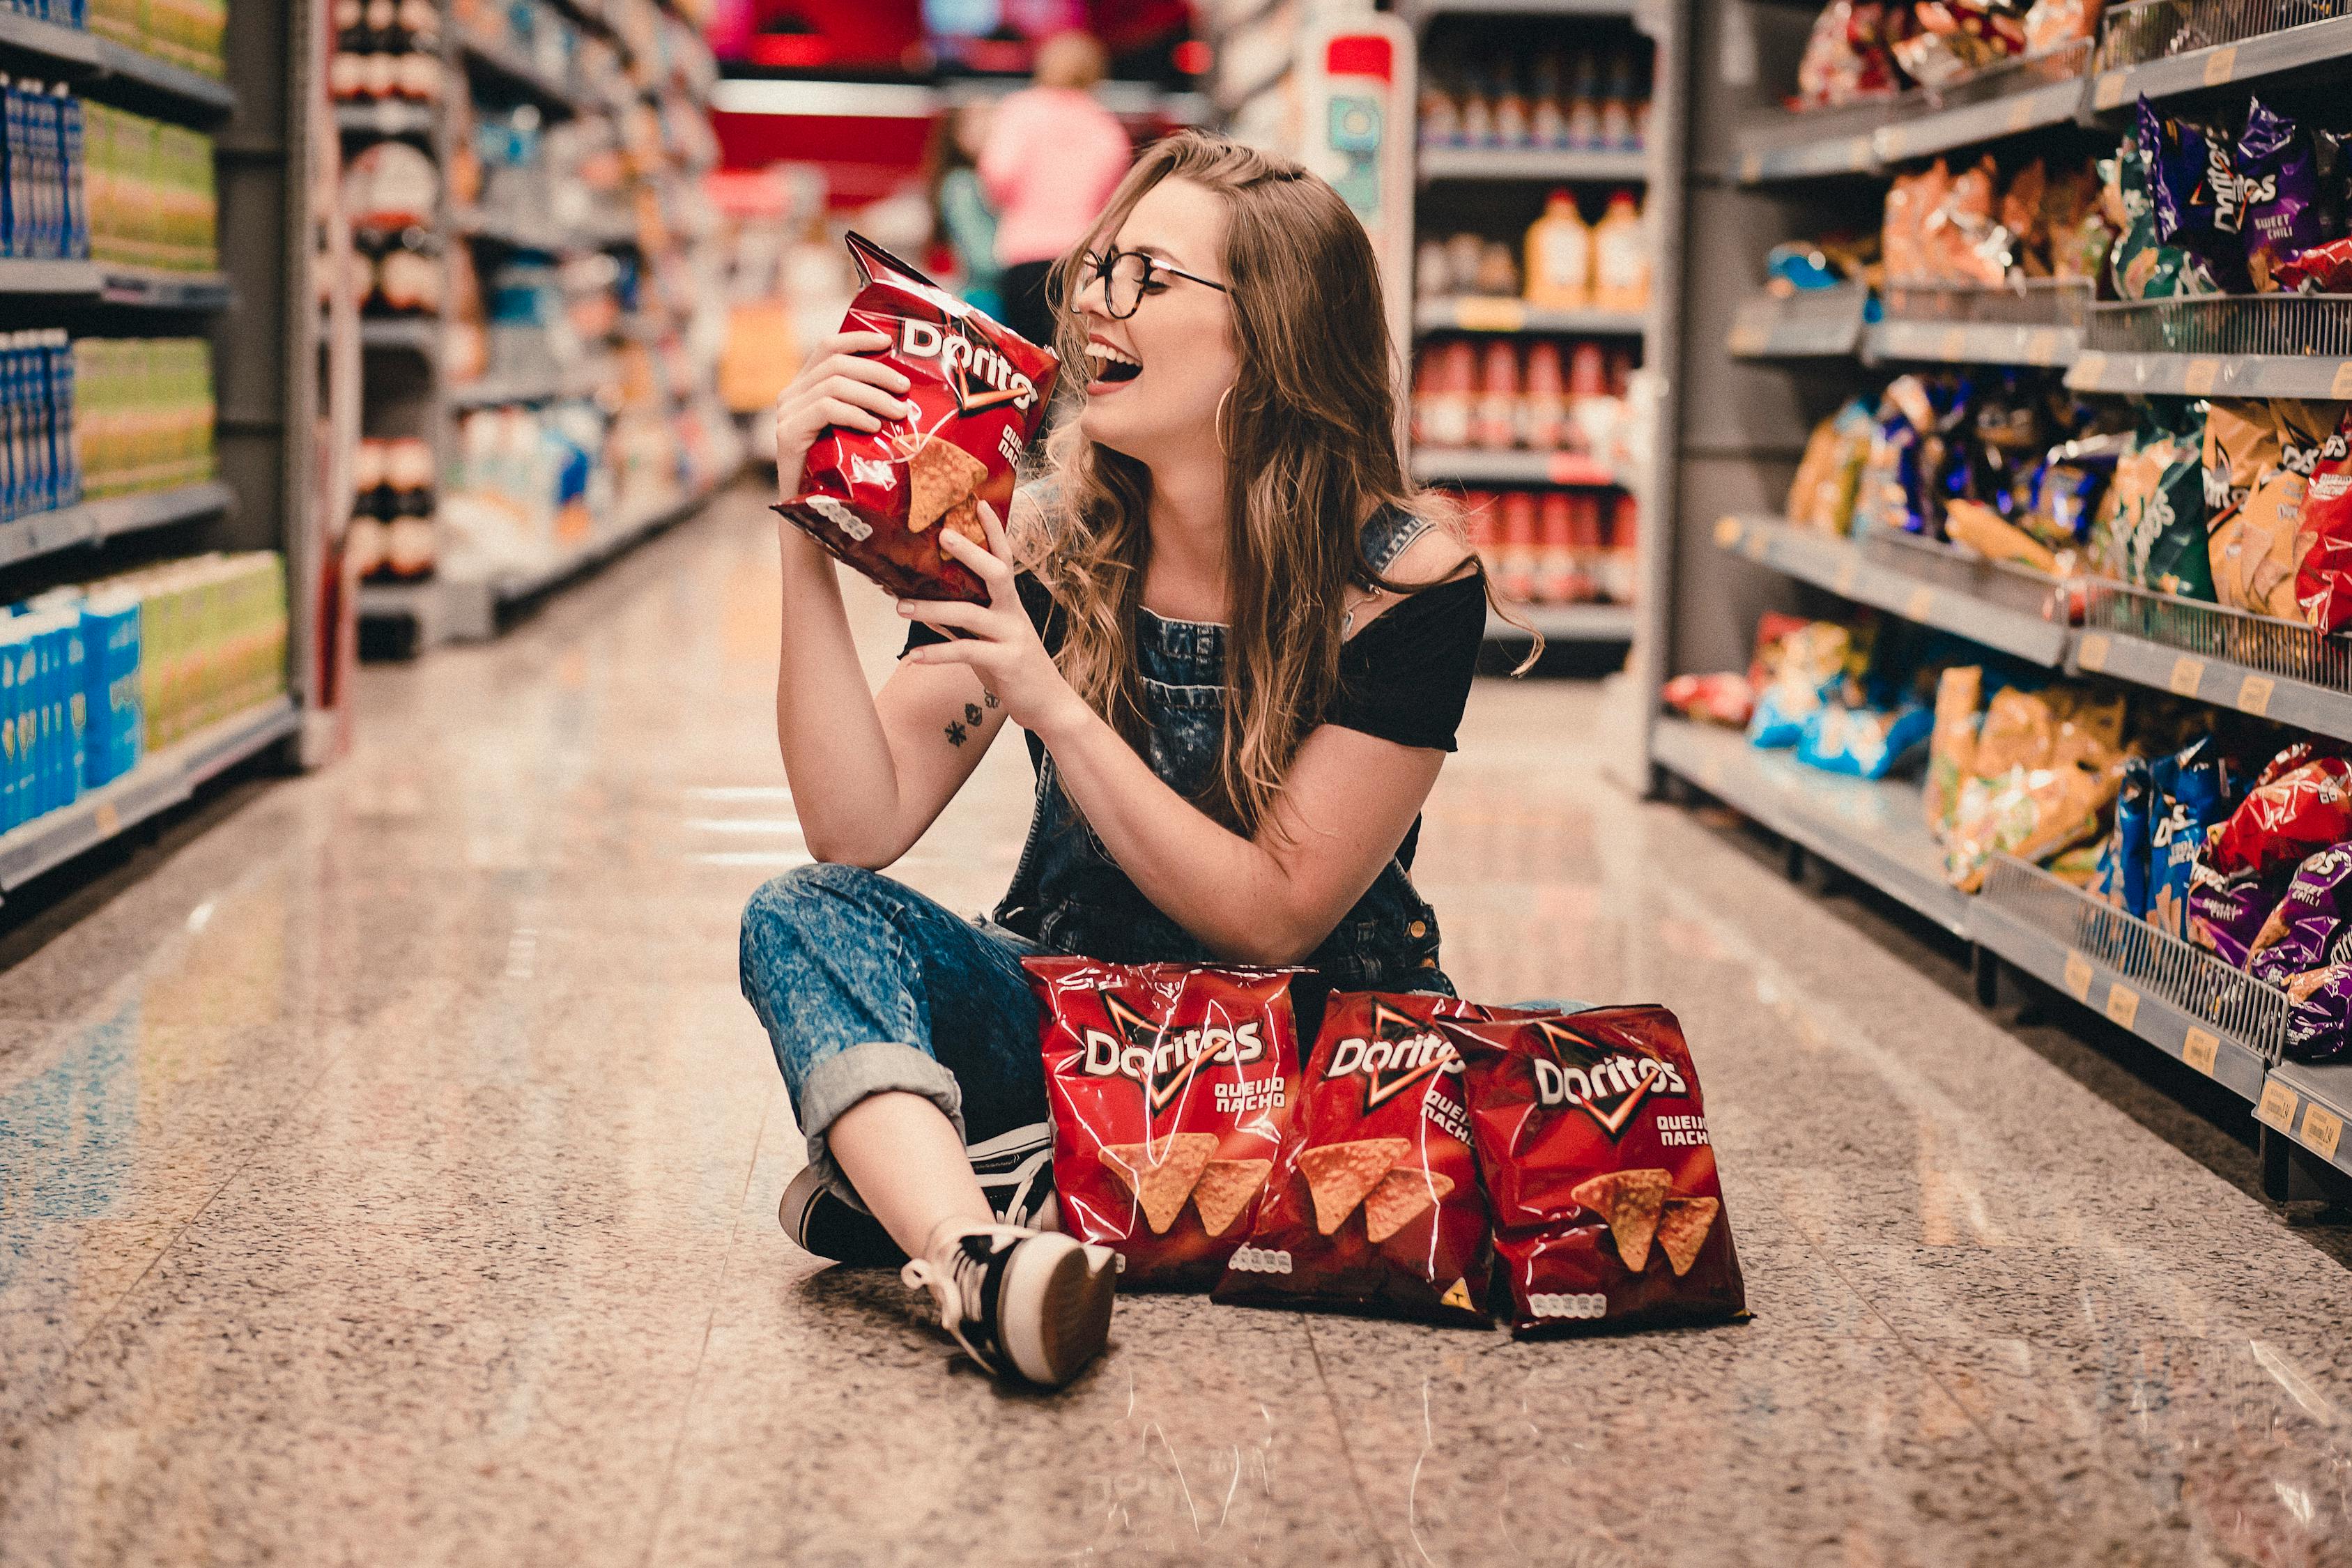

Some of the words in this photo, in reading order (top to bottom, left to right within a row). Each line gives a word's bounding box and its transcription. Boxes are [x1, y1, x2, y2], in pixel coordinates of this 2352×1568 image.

[2254, 213, 2291, 230] SWEET
[2267, 226, 2293, 240] CHILI
[998, 438, 1020, 470] NAC
[1002, 424, 1023, 454] QUE
[1084, 1022, 1263, 1077] Doritos
[1328, 1033, 1466, 1077] Dorito
[1215, 1077, 1284, 1098] QUEIJO
[1534, 1055, 1686, 1105] Doritos
[1216, 1093, 1285, 1112] NACHO
[1426, 1090, 1472, 1128] QUEI
[1661, 1130, 1709, 1146] NACH
